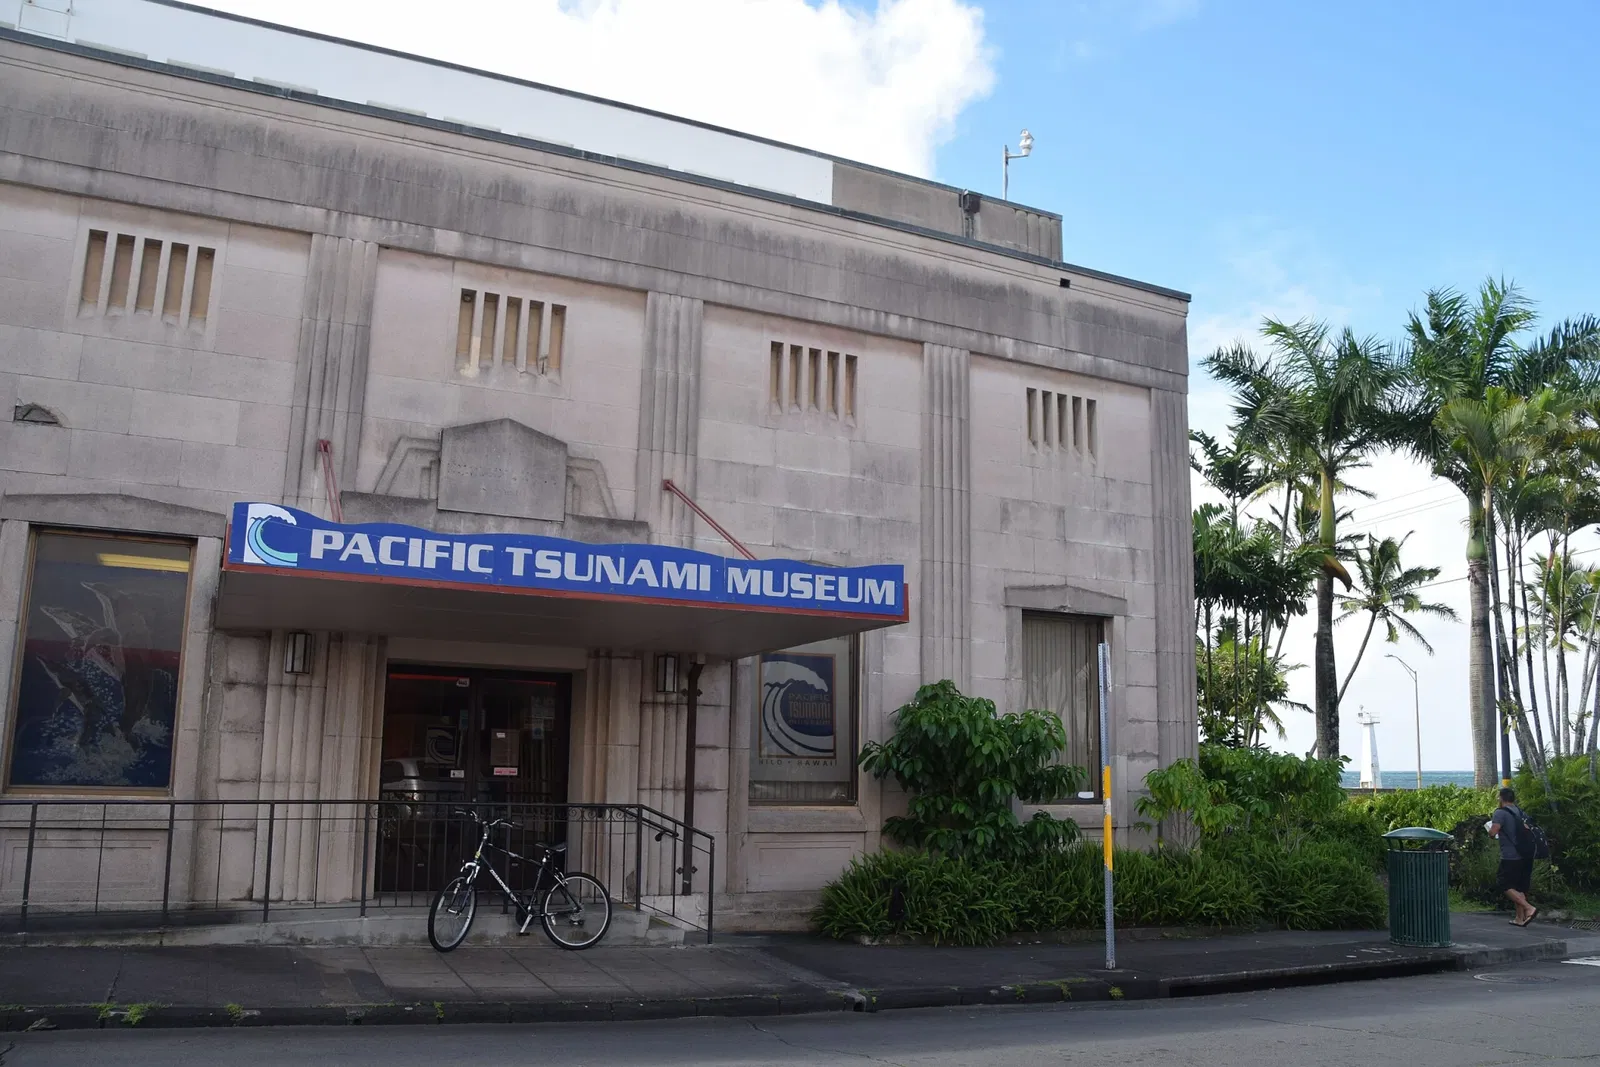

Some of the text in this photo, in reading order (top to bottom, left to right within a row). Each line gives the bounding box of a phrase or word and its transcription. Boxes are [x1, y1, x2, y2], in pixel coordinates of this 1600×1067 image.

[310, 529, 896, 605] PACIFIC TSUNAMI MUSEUM
